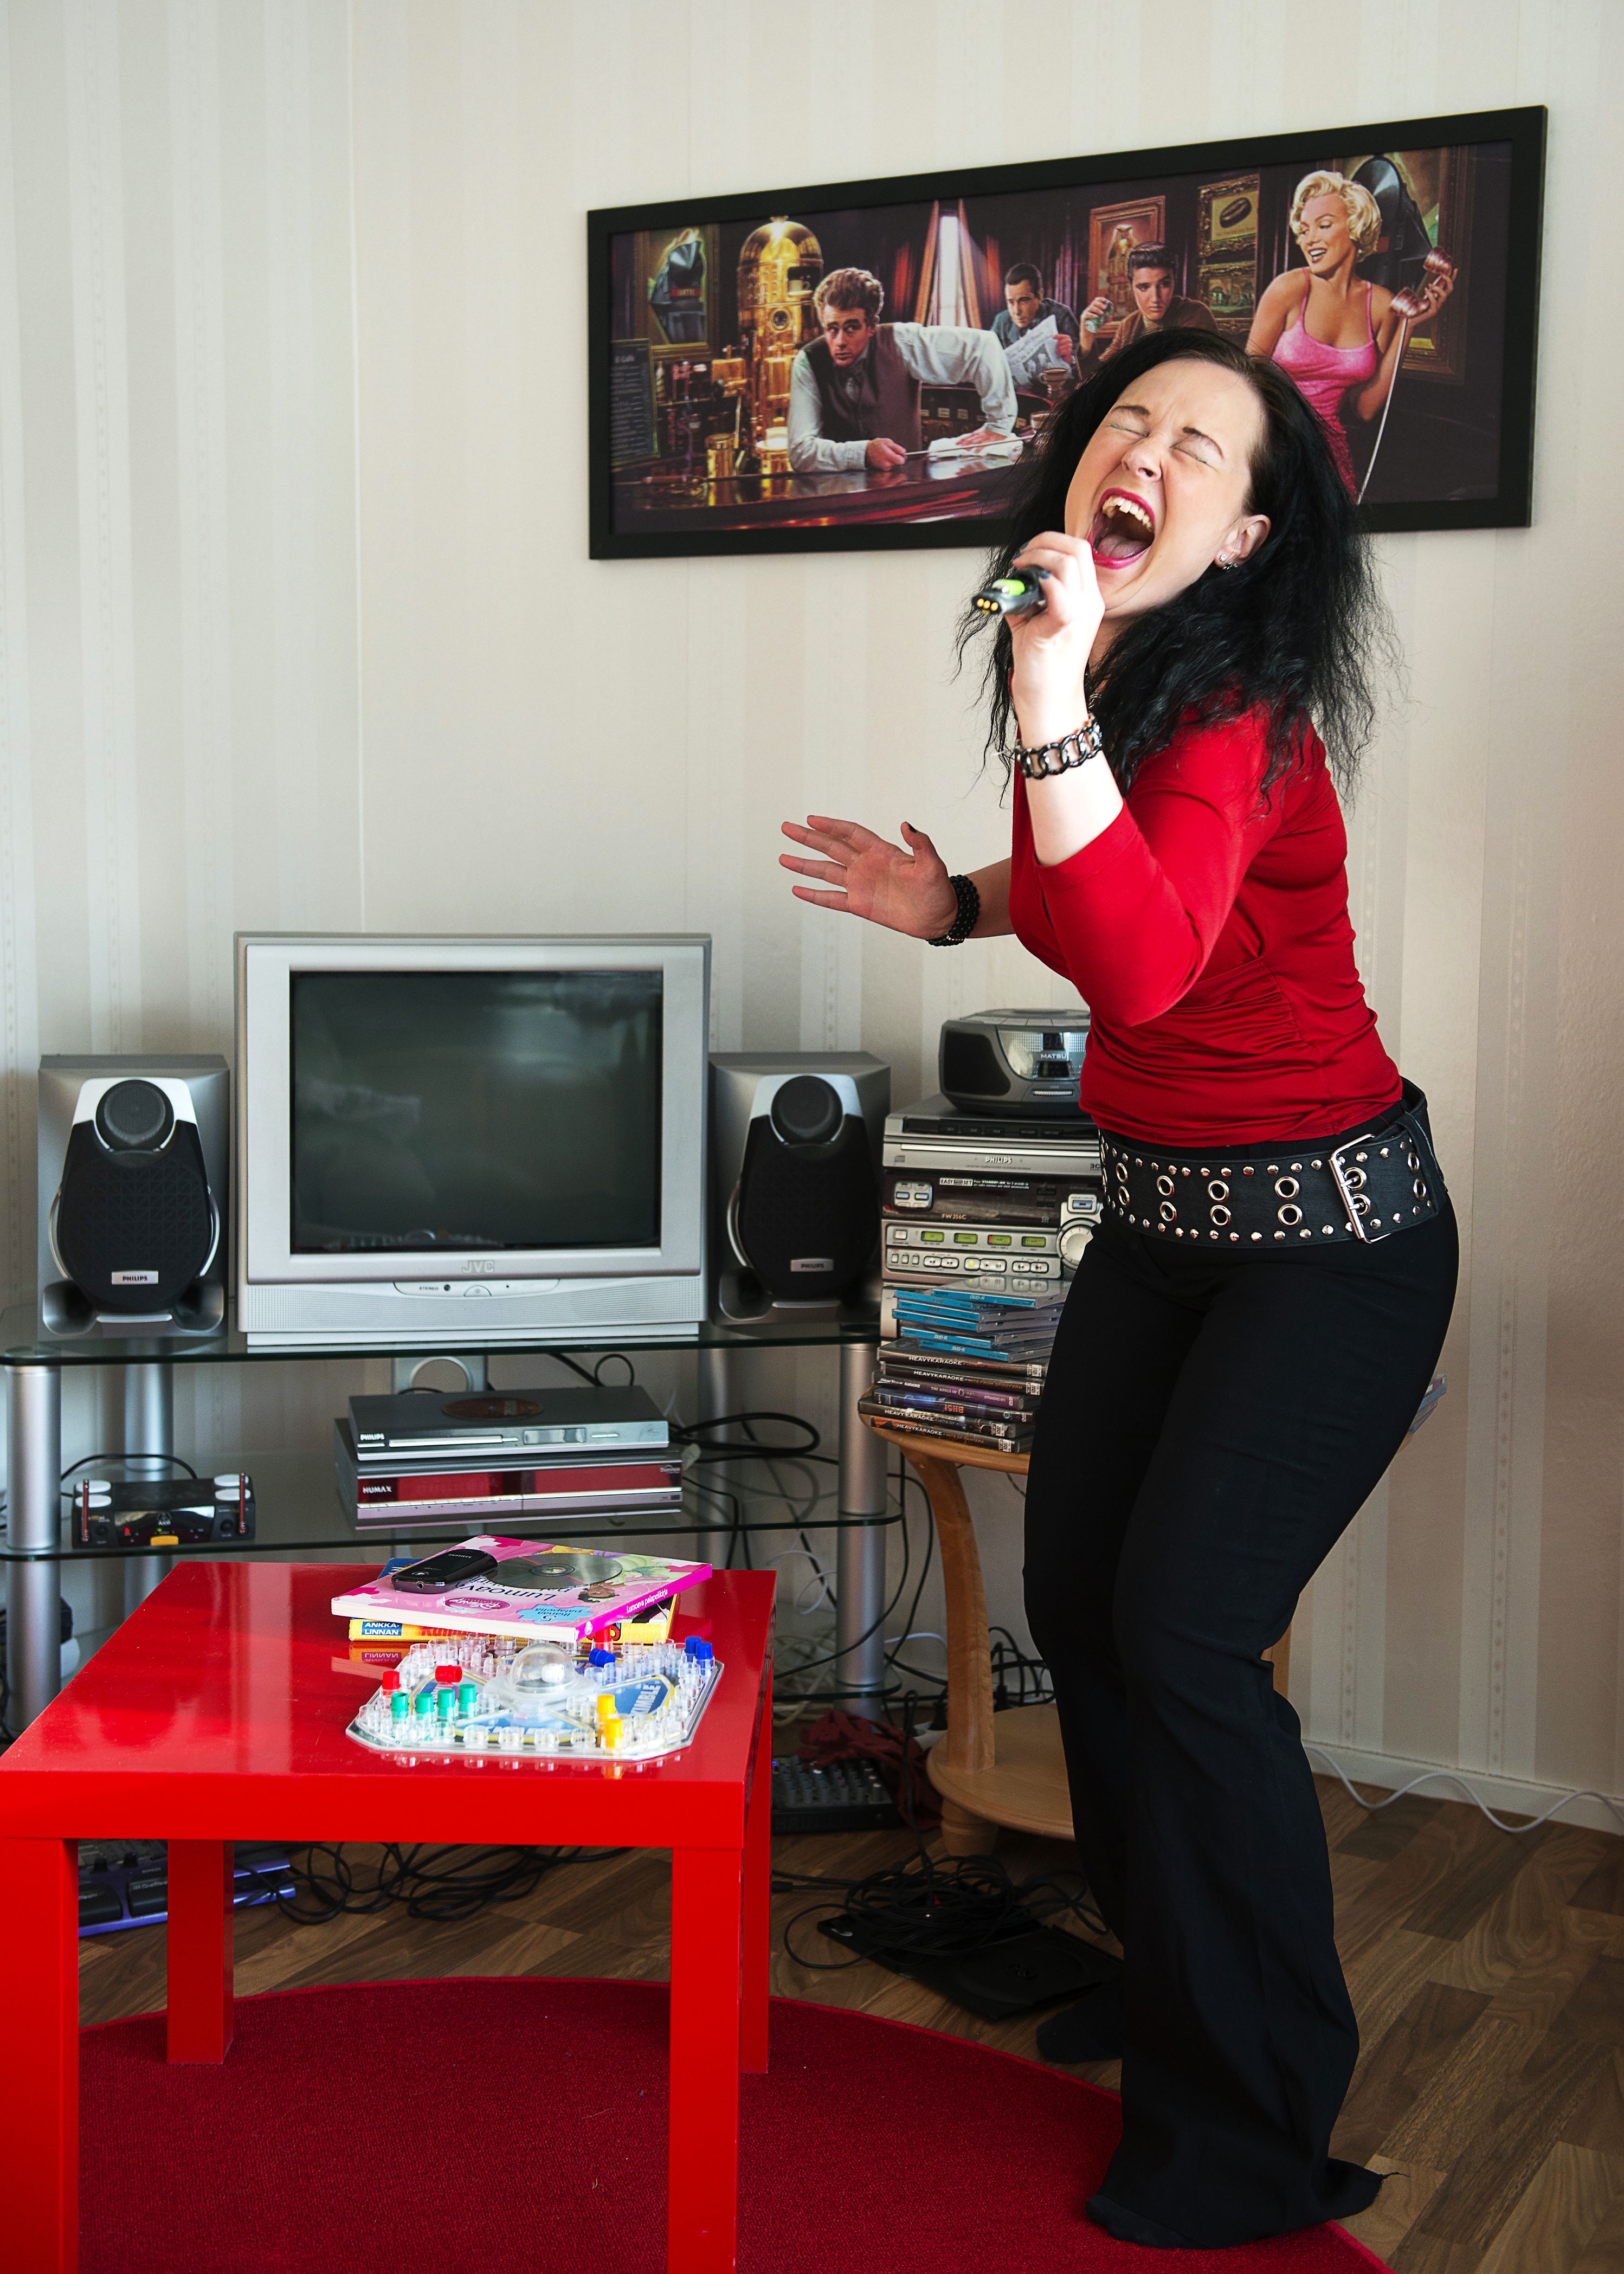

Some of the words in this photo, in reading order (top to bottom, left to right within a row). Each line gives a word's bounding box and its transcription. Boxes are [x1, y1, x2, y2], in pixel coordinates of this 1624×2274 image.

[462, 1260, 495, 1273] JVC
[909, 1356, 962, 1365] HEAVYKARAOKE
[914, 1370, 964, 1381] HEAVYKARAOKE
[897, 1423, 943, 1435] HEAVYKARAOKE
[449, 1598, 500, 1611] Disney
[627, 1600, 645, 1614] Lumoava
[645, 1588, 668, 1607] palapelikirja
